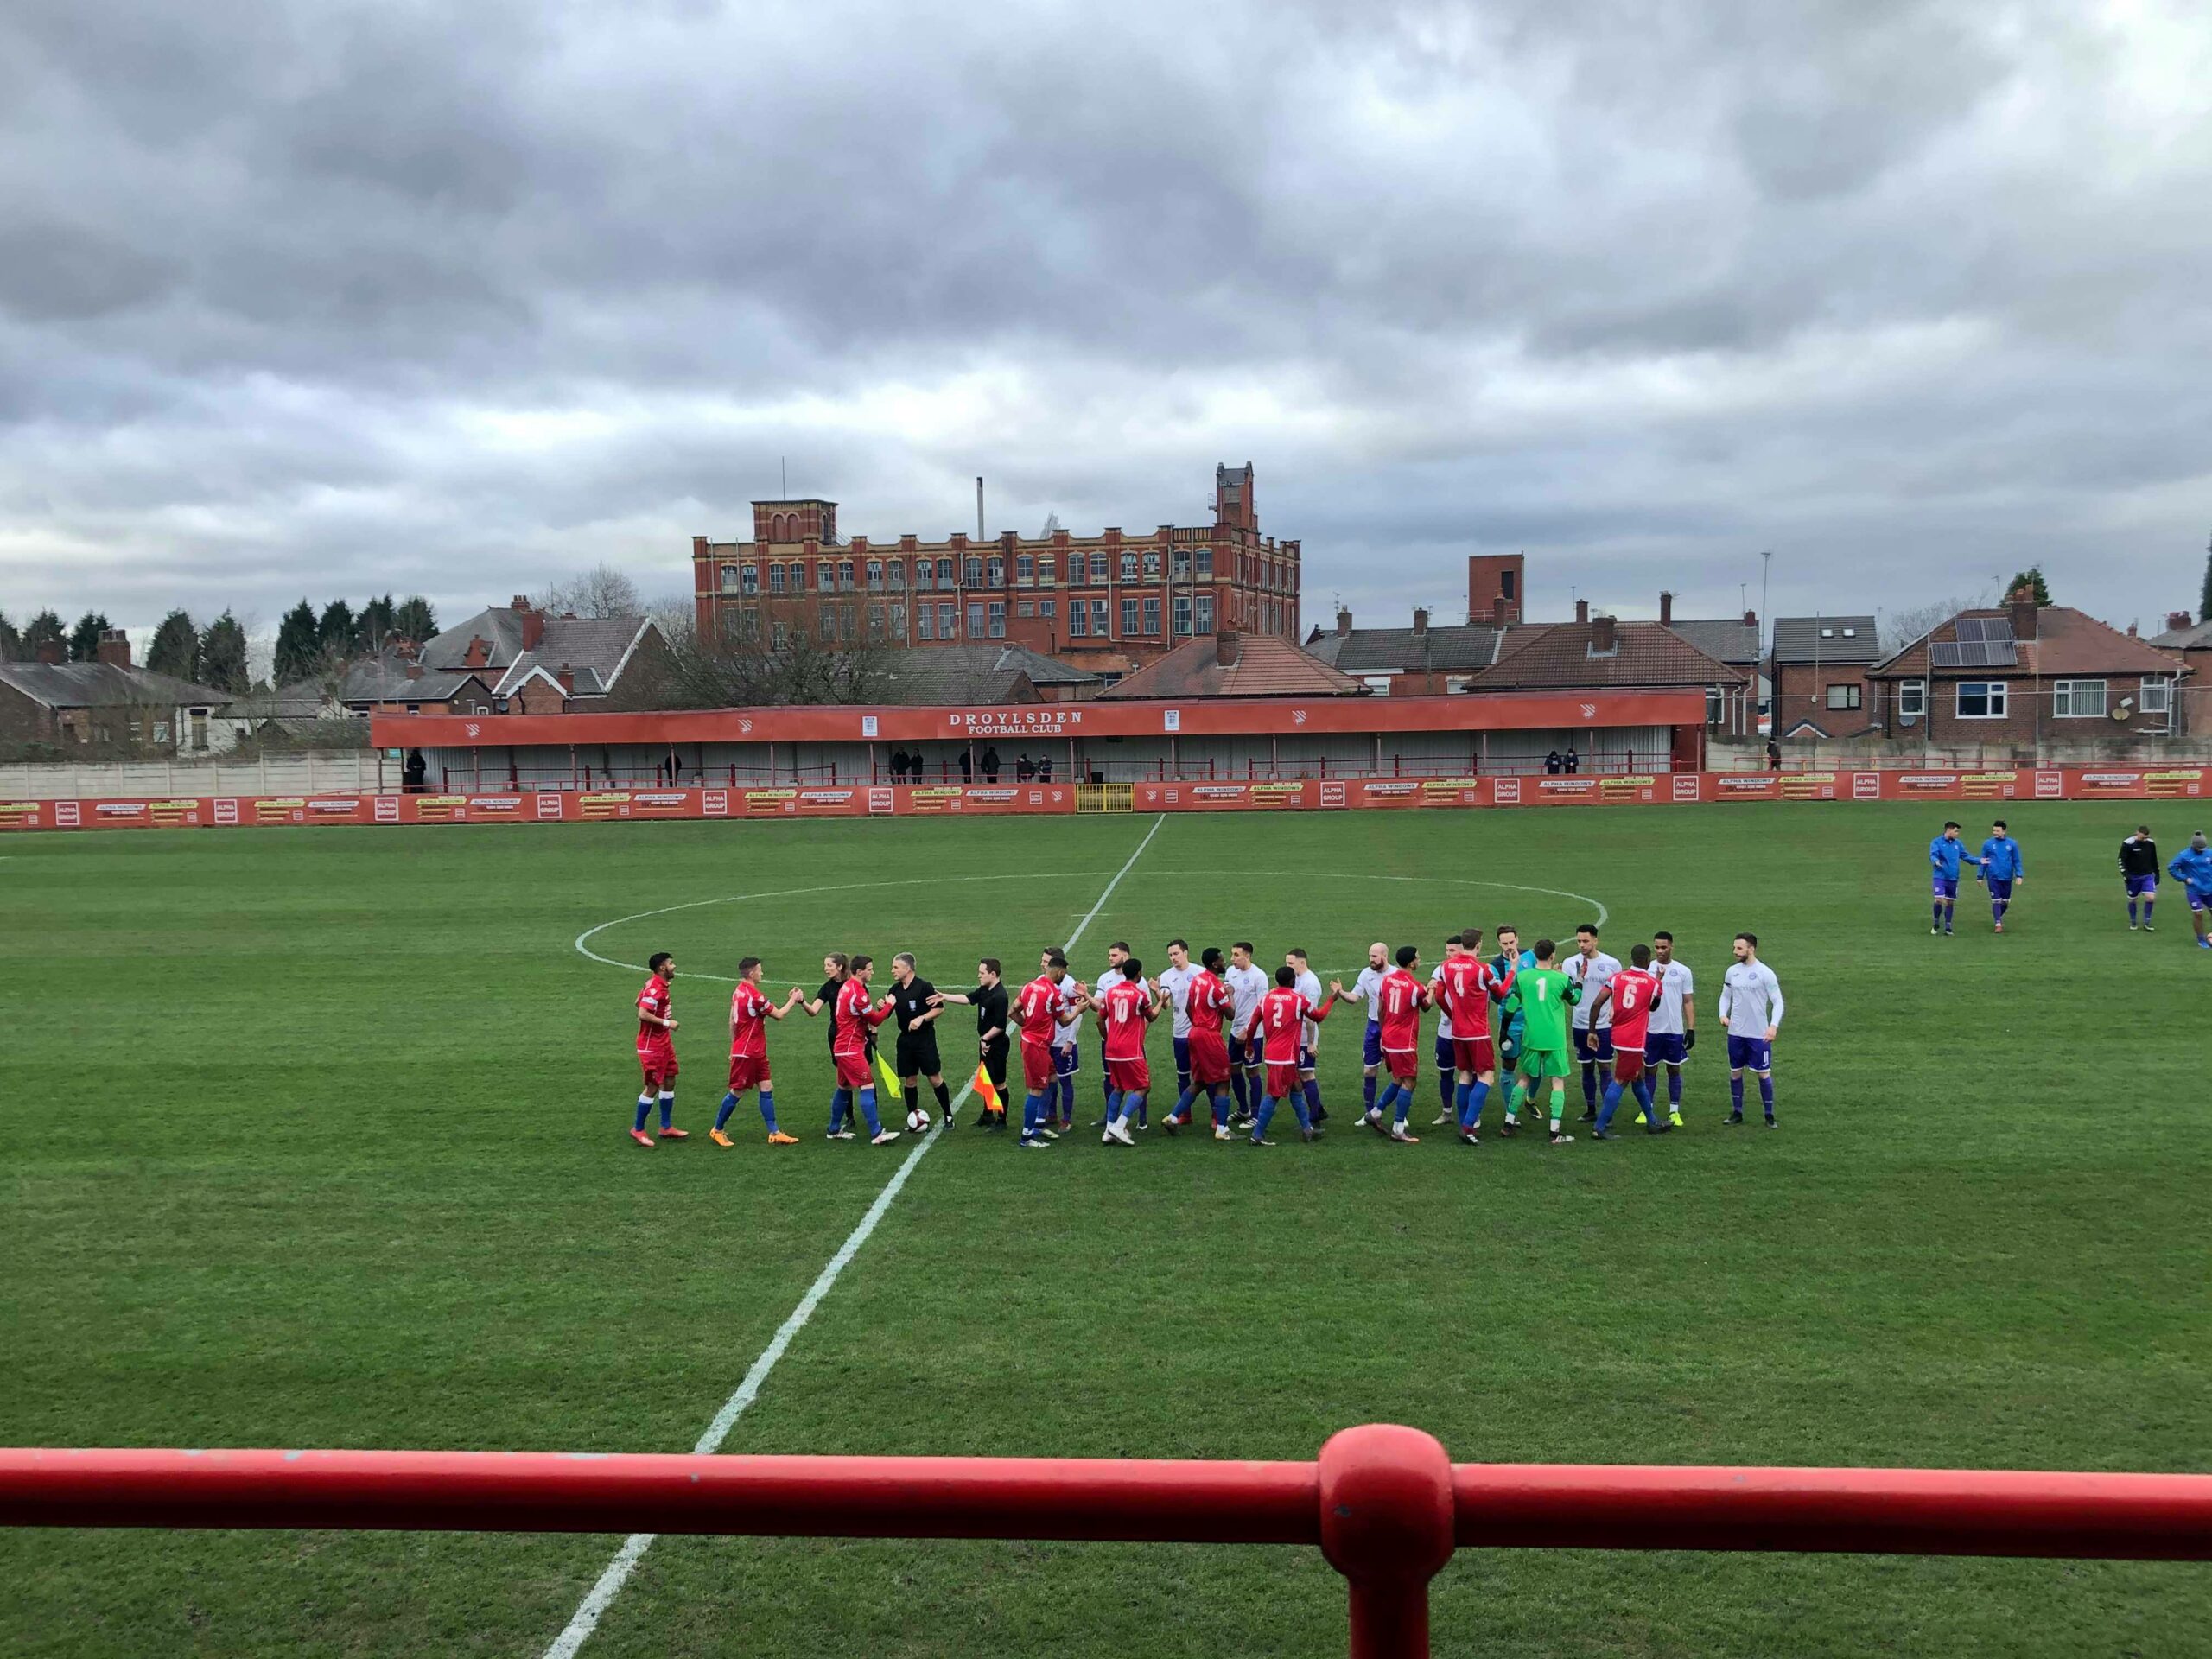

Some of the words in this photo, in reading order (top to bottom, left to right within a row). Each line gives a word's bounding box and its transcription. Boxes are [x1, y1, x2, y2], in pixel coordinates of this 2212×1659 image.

[949, 712, 1082, 726] DROYLSDEN
[968, 725, 1029, 734] FOOTBALL
[1031, 724, 1062, 733] CLUB
[1454, 972, 1464, 997] 4
[1536, 977, 1546, 1001] 1
[1621, 974, 1648, 984] macron
[1026, 993, 1037, 1017] 9
[1389, 987, 1401, 1014] 11
[1622, 984, 1637, 1009] 6
[1112, 998, 1128, 1023] 10
[1273, 1002, 1283, 1027] 2
[1068, 1055, 1073, 1066] 3
